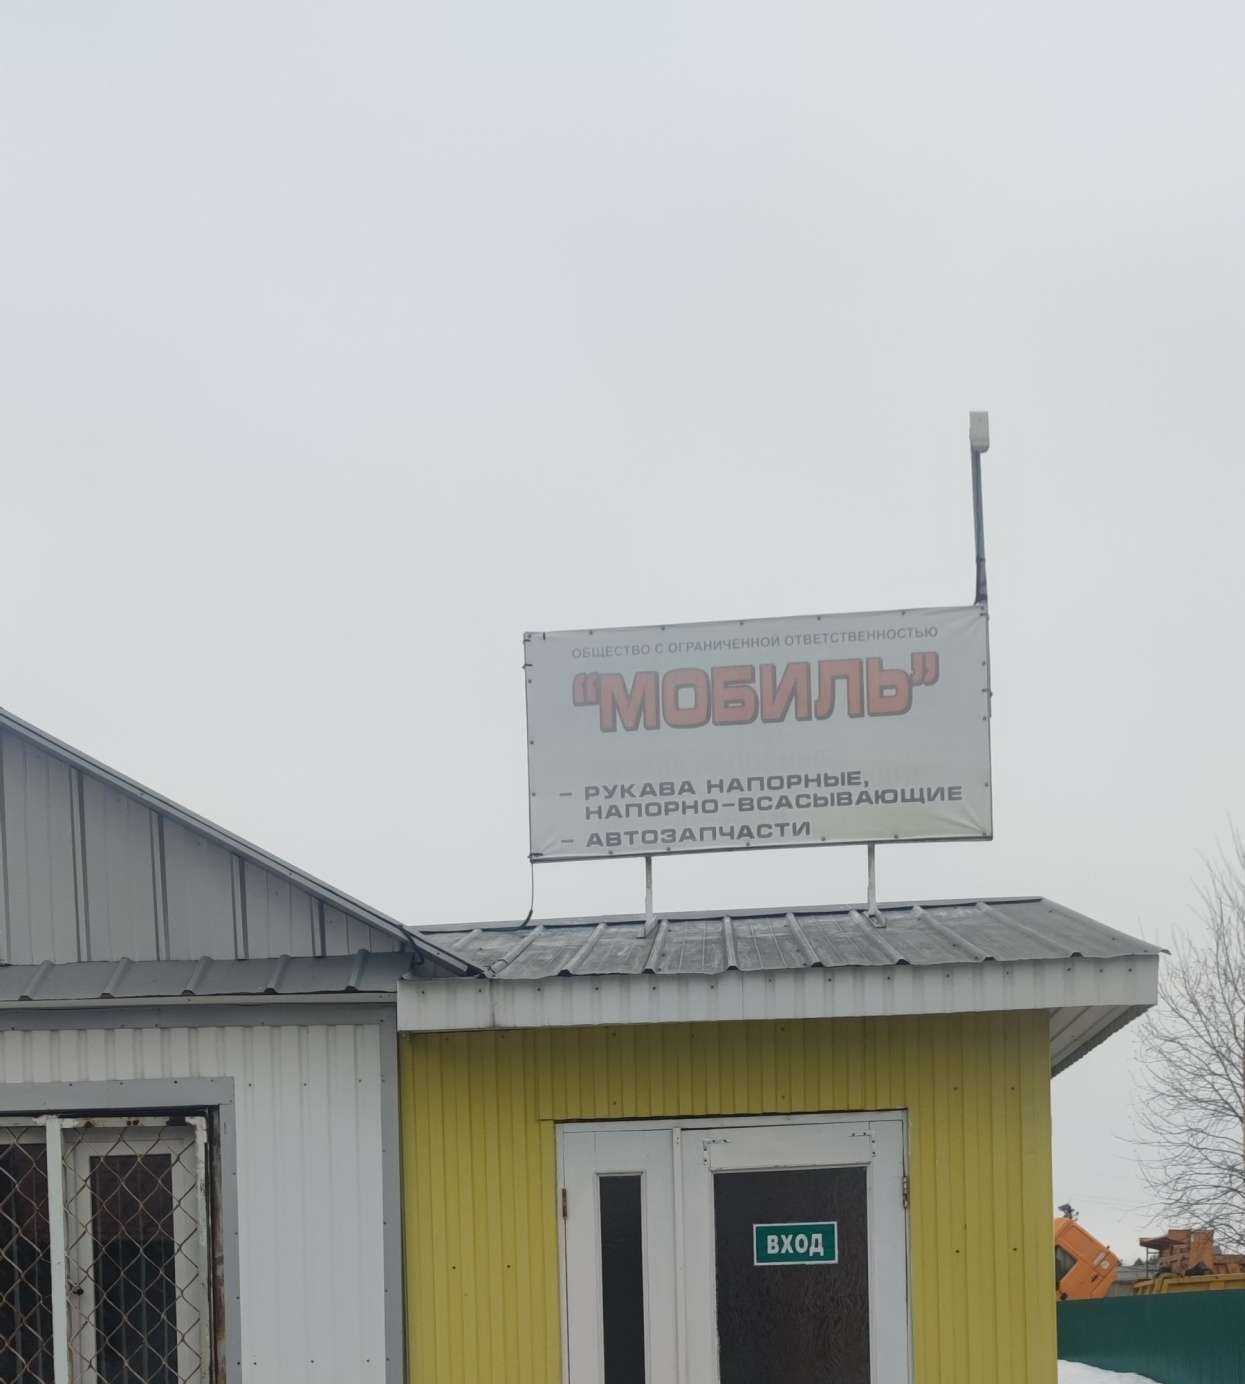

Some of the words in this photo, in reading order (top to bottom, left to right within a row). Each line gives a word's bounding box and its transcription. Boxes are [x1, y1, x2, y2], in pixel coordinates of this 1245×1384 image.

[572, 643, 650, 660] ОБЩЕСТВО
[654, 642, 664, 654] С
[667, 635, 781, 653] ОГРАНИЧЕННОЙ
[785, 626, 939, 646] ОТВЕТСТВЕННОСТЬЮ
[585, 779, 696, 801] РУКАВА
[706, 771, 870, 795] НАПОРНЫЕ,
[585, 785, 963, 820] НАПОРНО-ВСАСЫВАЮЩИЕ
[585, 821, 811, 848] АВТОЗАПЧАСТИ
[766, 1233, 824, 1257] ВХОД
